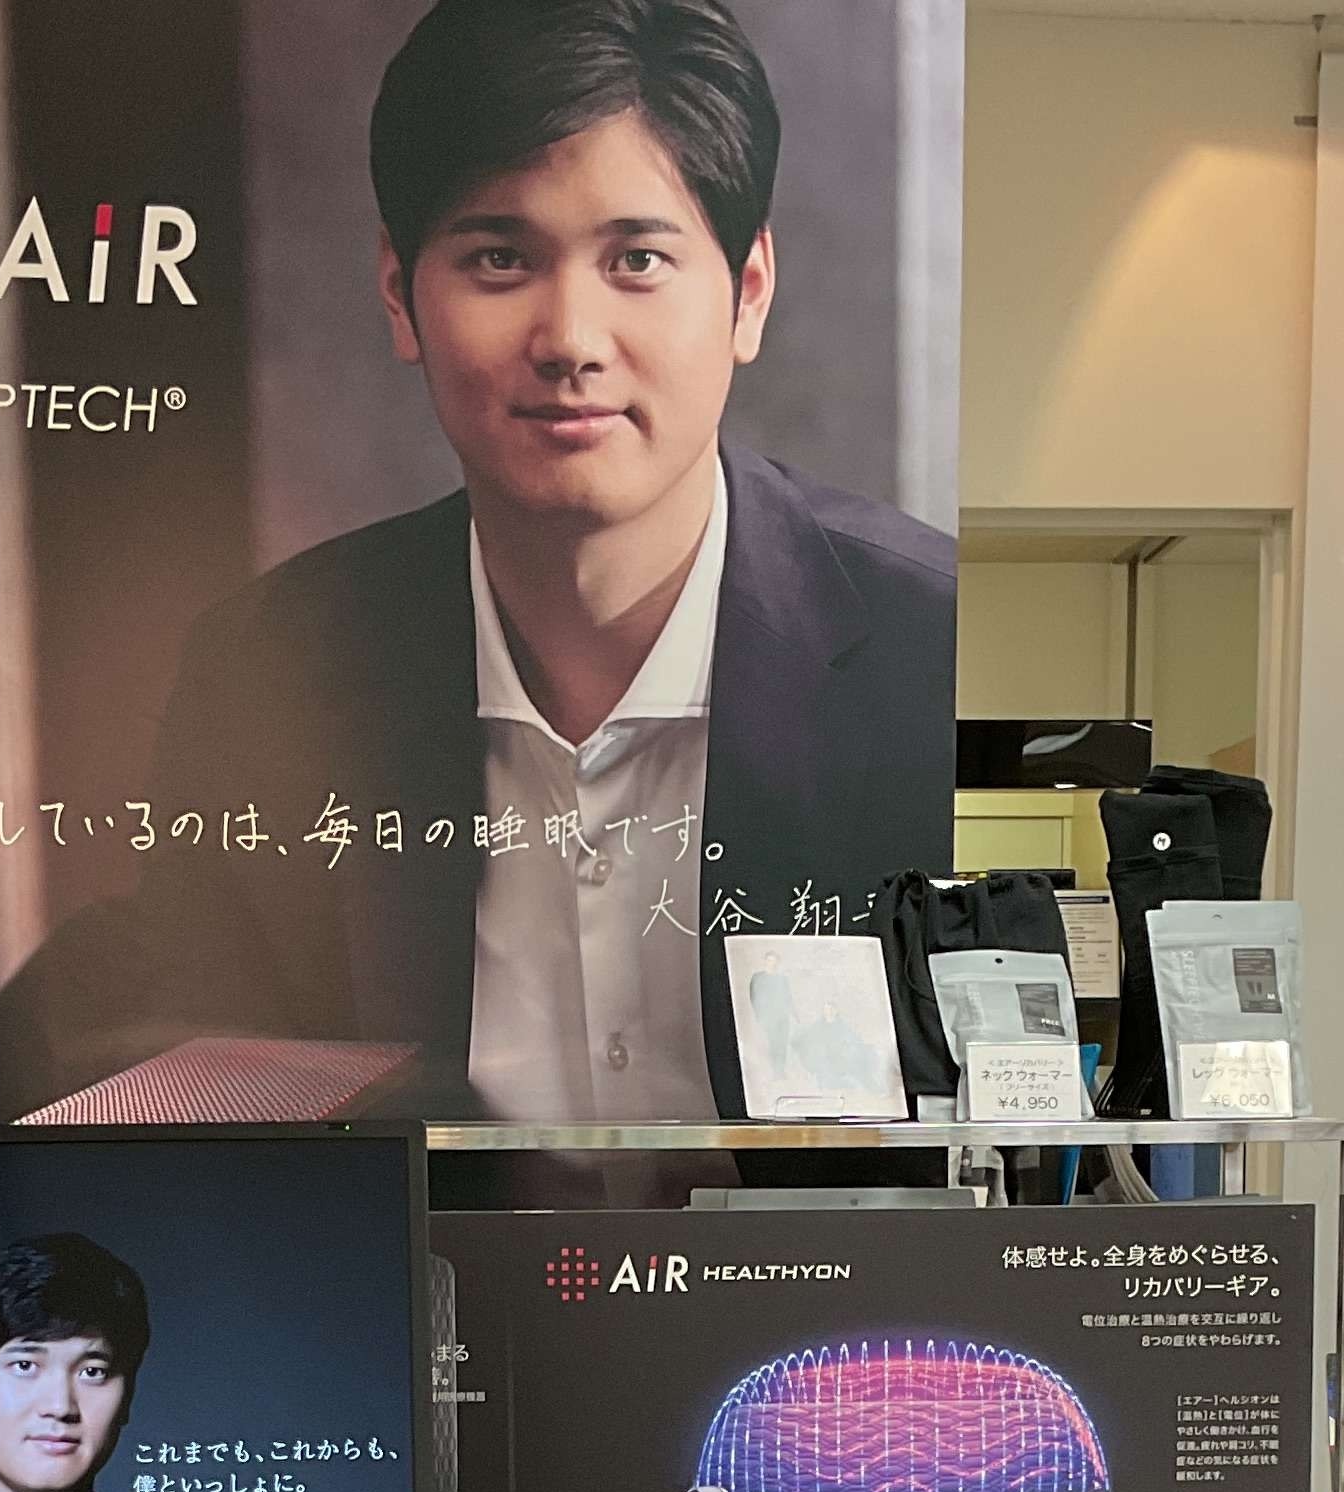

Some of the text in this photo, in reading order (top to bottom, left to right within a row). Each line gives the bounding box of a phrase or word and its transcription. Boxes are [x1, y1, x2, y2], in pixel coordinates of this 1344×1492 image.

[1001, 1243, 1281, 1269] 体感せよ。全身をめぐらせる、
[703, 1264, 852, 1281] HEALTHYON
[1123, 1276, 1281, 1299] リカバリーギア。
[431, 1344, 469, 1361] まる
[134, 1437, 400, 1465] これまでも、これからも、
